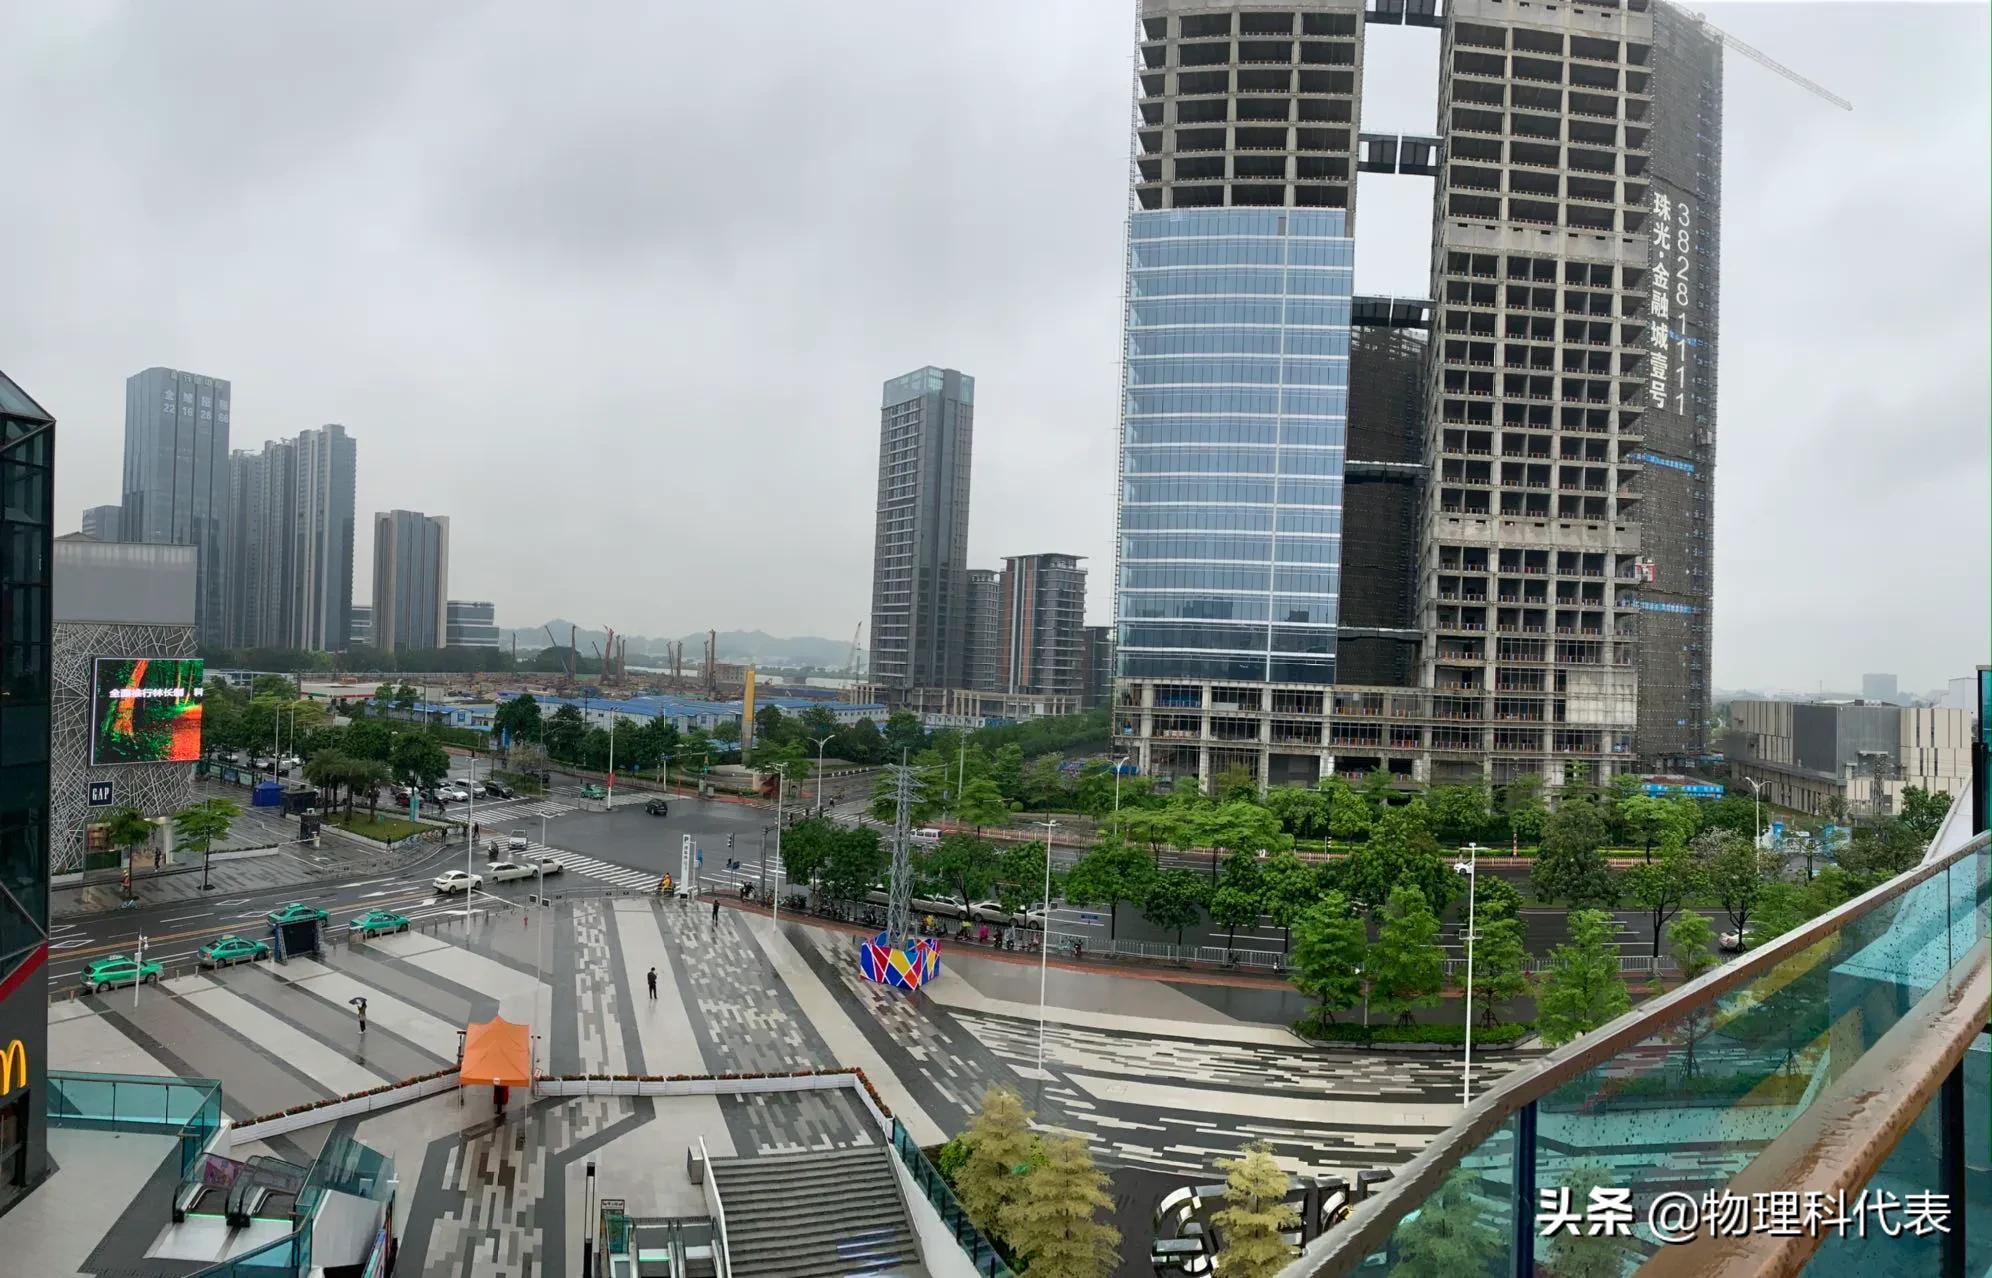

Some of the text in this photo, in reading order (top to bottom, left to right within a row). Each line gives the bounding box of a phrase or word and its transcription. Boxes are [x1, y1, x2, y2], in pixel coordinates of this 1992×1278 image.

[1649, 191, 1671, 409] 珠光·金融城壹号
[1675, 202, 1691, 416] 38281111
[92, 786, 110, 801] GAP
